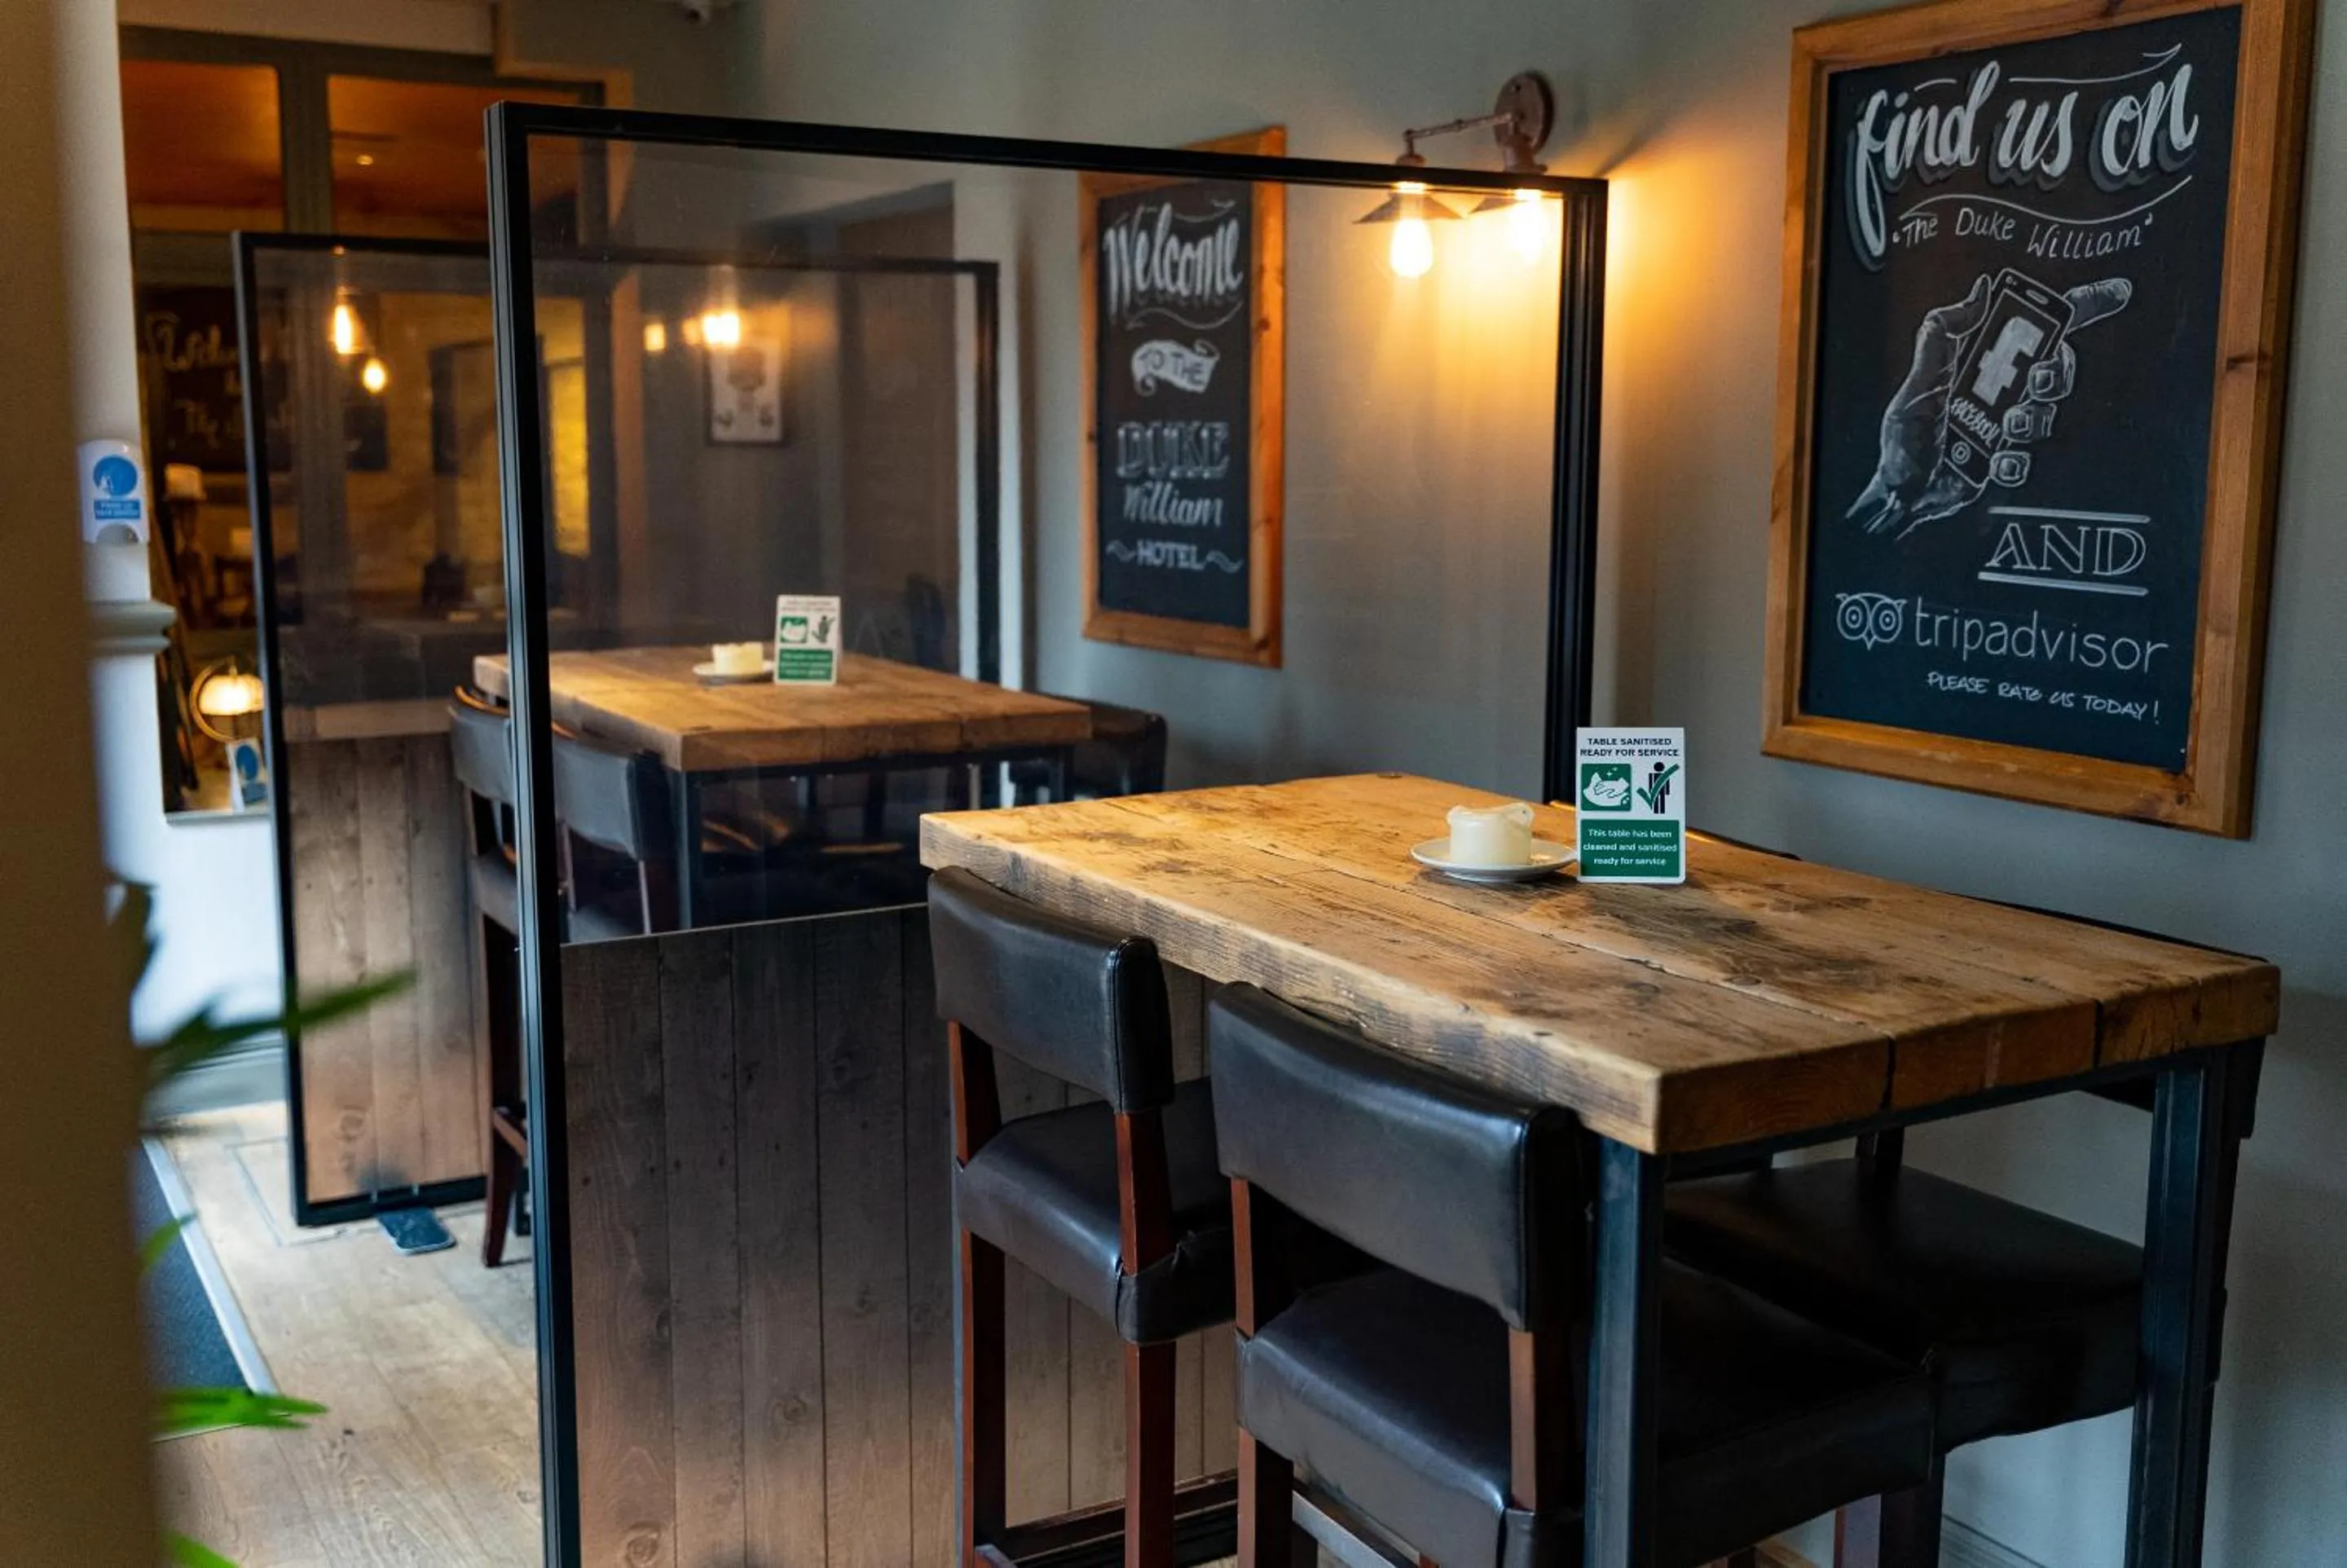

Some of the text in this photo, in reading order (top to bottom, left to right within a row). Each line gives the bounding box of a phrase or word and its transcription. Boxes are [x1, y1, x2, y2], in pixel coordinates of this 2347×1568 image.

[1997, 90, 2079, 178] us
[1955, 206, 2017, 241] Duke
[1103, 201, 1244, 319] Welcome
[1116, 421, 1231, 479] DUKE
[1123, 481, 1225, 528] William
[1136, 538, 1205, 570] HOTEL
[1984, 522, 2148, 576] AND
[1914, 596, 2170, 674] tripadvisor
[1926, 671, 1990, 694] PLEASE
[1579, 748, 1680, 757] READY FOR SERVICE
[1587, 738, 1672, 746] TABLE SANITISED
[1583, 843, 1678, 852] cleaned and sanitised
[1588, 829, 1672, 839] This table has been
[1593, 857, 1667, 867] ready for service
